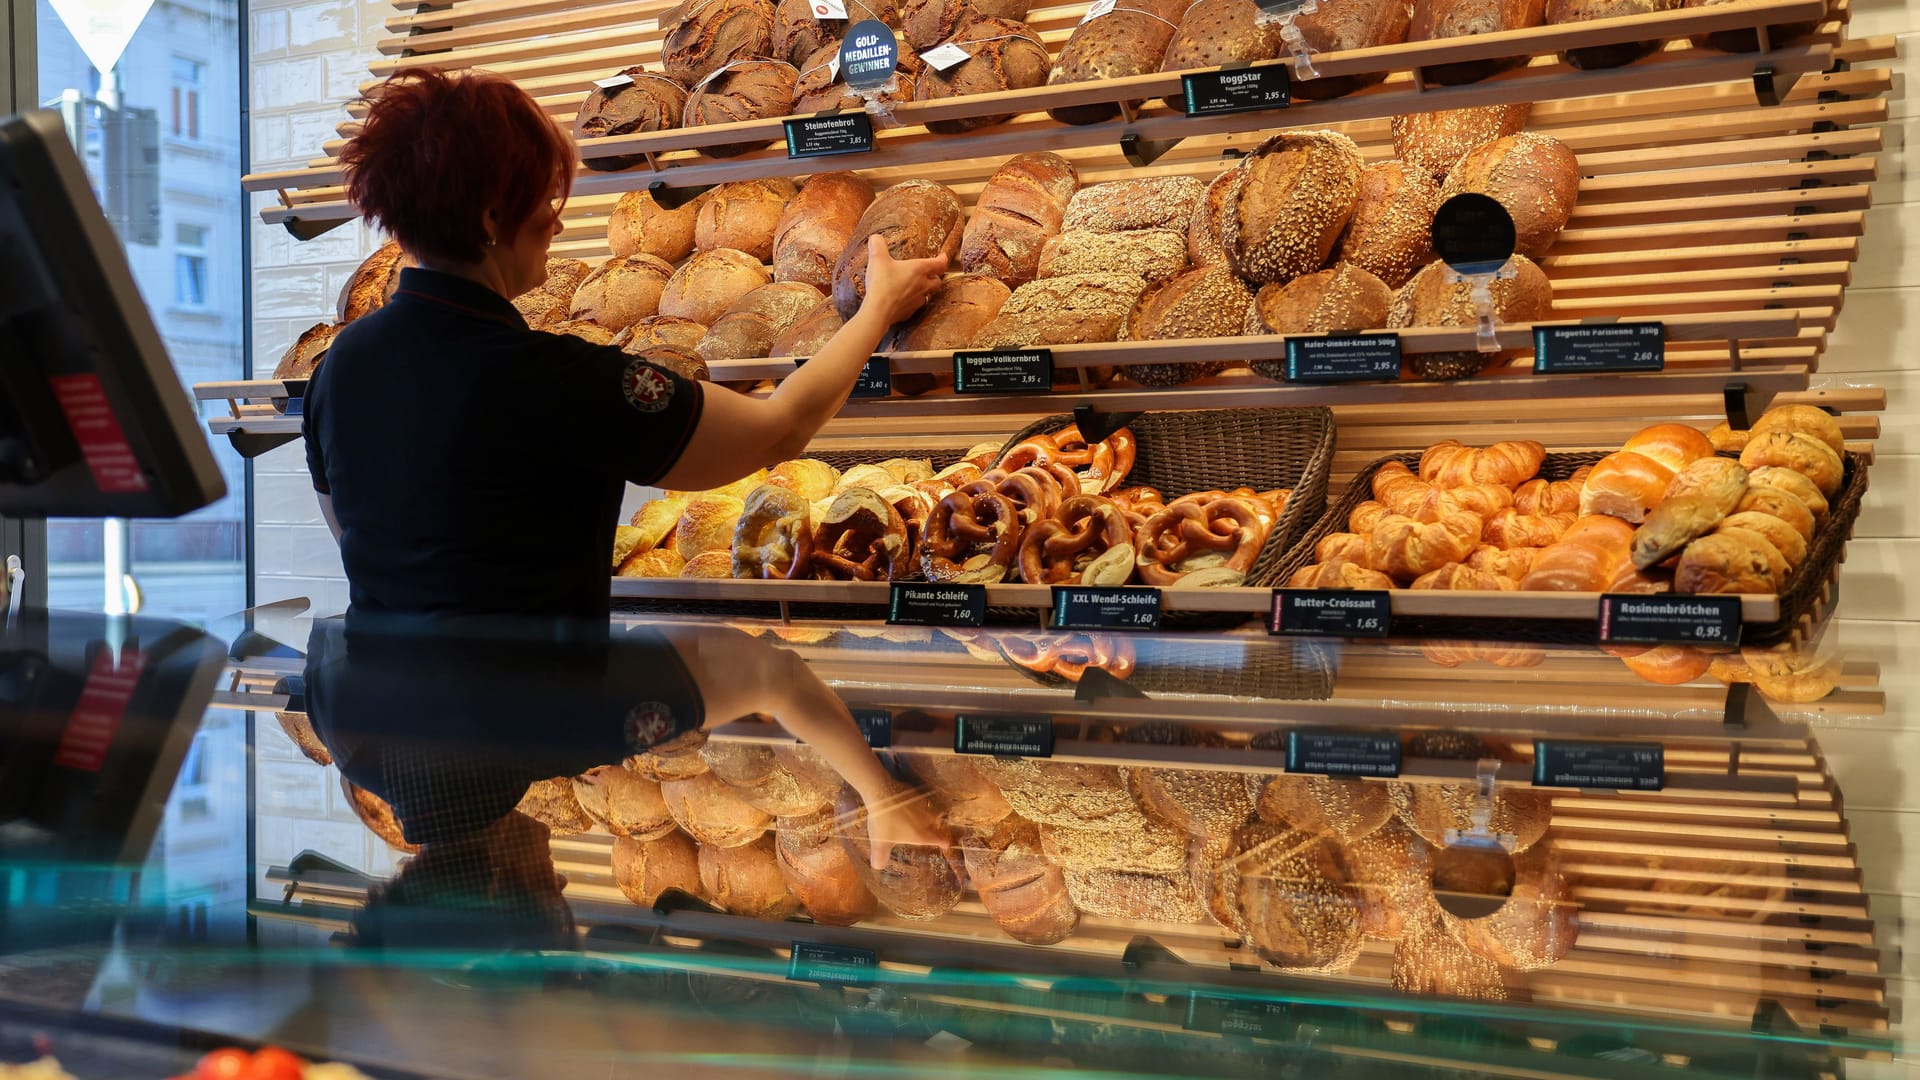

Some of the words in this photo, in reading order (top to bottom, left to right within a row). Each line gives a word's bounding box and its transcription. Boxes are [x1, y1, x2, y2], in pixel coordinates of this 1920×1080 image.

[855, 34, 880, 48] GOLD-
[845, 44, 892, 62] MEDAILLEN-
[848, 57, 890, 75] GEWINNER
[1220, 73, 1261, 85] RoggStar
[1264, 91, 1280, 100] 3,95
[804, 118, 855, 131] Steinofenbrot
[849, 136, 862, 144] 3,85
[1555, 330, 1590, 339] Baguette
[1592, 327, 1634, 337] Parisienne
[1304, 339, 1376, 349] Hafer-Dinkel-Kruste
[1633, 351, 1652, 361] 2,60
[1373, 361, 1391, 370] 3,95
[869, 381, 883, 389] 3,40
[1022, 375, 1036, 384] 3,95
[905, 590, 935, 600] Pikante
[936, 591, 969, 601] Schleife
[1072, 594, 1089, 603] XXL
[1091, 594, 1157, 605] Wendl-Schleife
[1294, 597, 1376, 608] Butter-Croissant
[953, 609, 971, 619] 1,60
[1620, 602, 1720, 616] Rosinenbrötchen
[1133, 613, 1153, 624] 1,60
[1356, 617, 1379, 629] 1,65
[1695, 625, 1721, 637] 0,95
